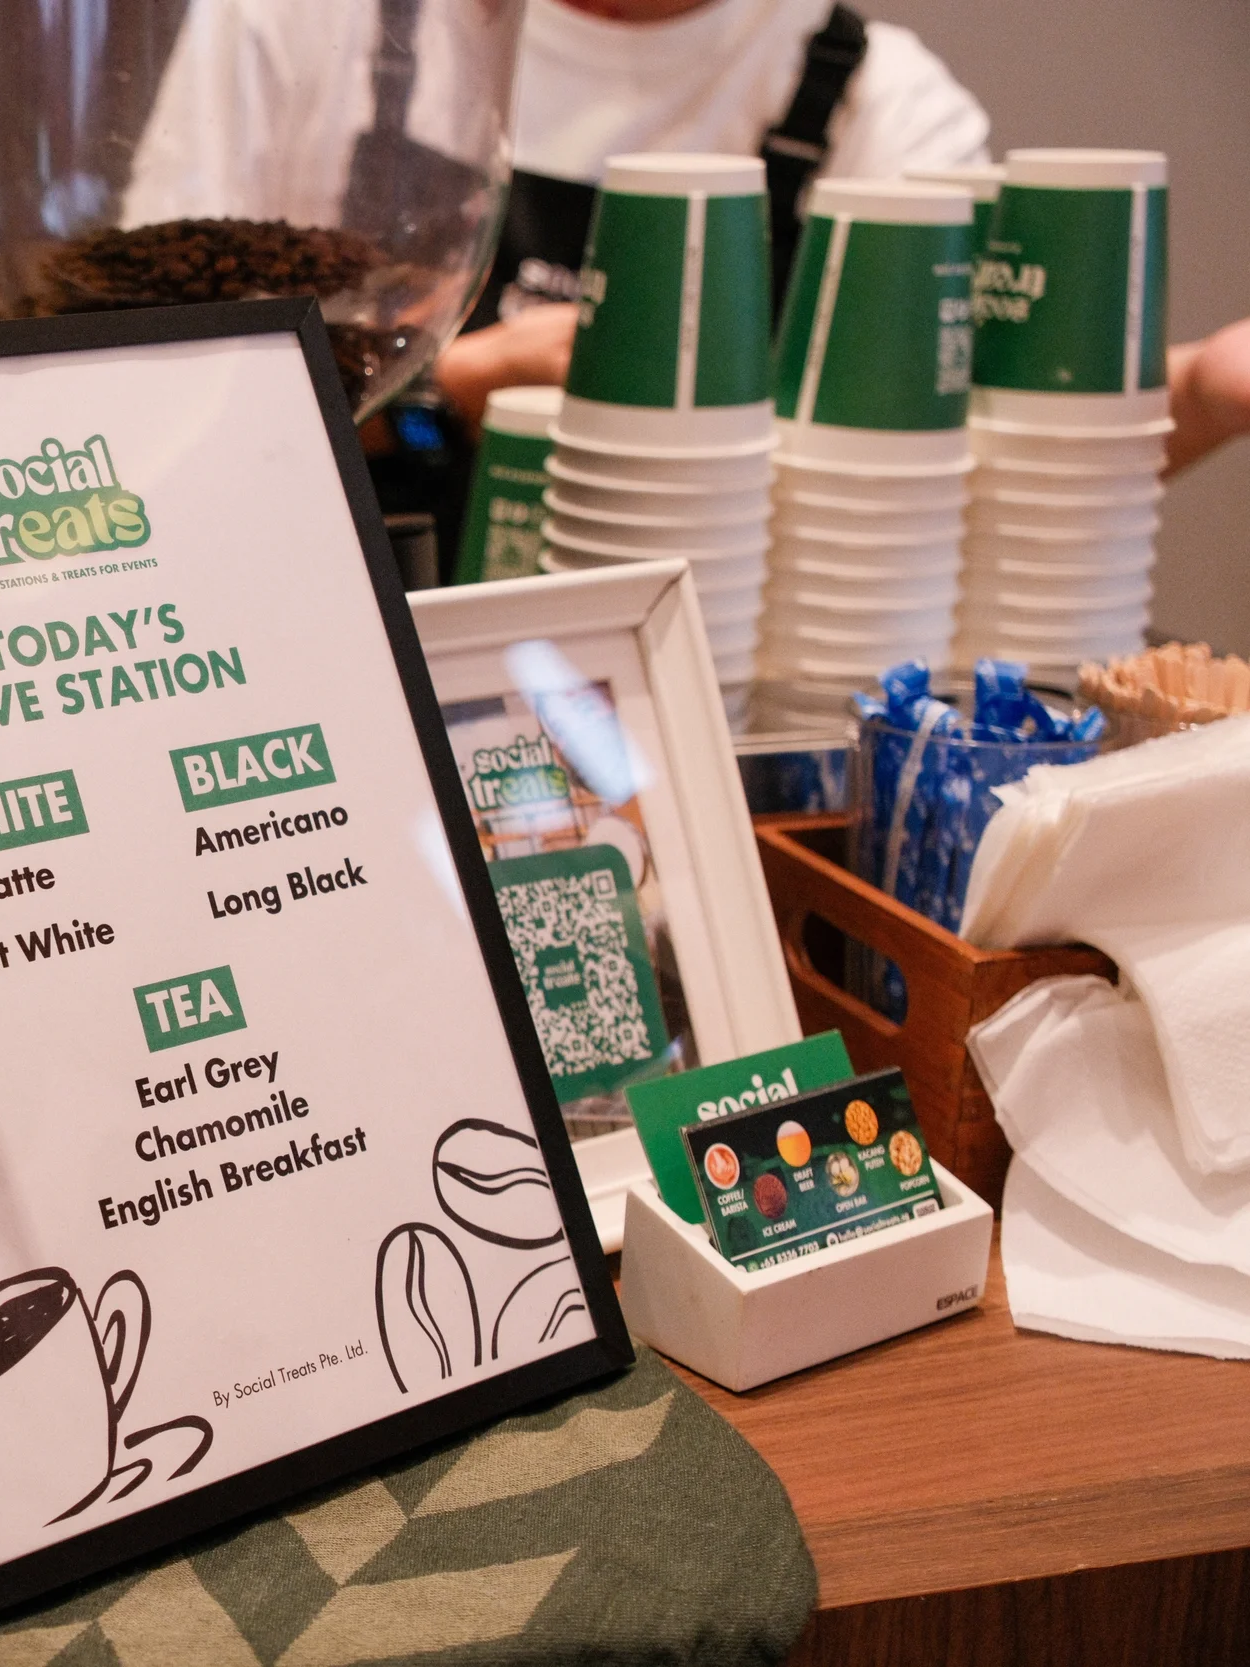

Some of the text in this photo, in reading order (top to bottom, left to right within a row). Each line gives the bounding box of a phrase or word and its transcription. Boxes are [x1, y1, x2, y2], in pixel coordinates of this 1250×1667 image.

[0, 574, 49, 591] STATIONS
[51, 572, 60, 582] &
[61, 567, 97, 581] TREATS
[99, 563, 120, 576] FOR
[122, 558, 158, 572] EVENTS
[55, 646, 247, 715] STATION
[182, 732, 324, 796] BLACK
[474, 735, 551, 772] social
[195, 806, 349, 857] Americano
[206, 857, 369, 919] Long Black
[14, 918, 116, 963] White
[144, 978, 234, 1034] TEA
[135, 1050, 279, 1109] Earl Grey
[134, 1089, 310, 1162] Chamomile
[98, 1126, 367, 1230] English Breakfast
[793, 1166, 814, 1182] DRAFT
[798, 1179, 815, 1192] BEER
[899, 1174, 930, 1192] POPCORN
[720, 1201, 749, 1217] BARISTA
[835, 1194, 868, 1213] OPEN BAR
[762, 1219, 797, 1238] ICE CREAM
[936, 1284, 979, 1311] ESPACE
[213, 1339, 369, 1408] By Social Treats Pte. Ltd.
